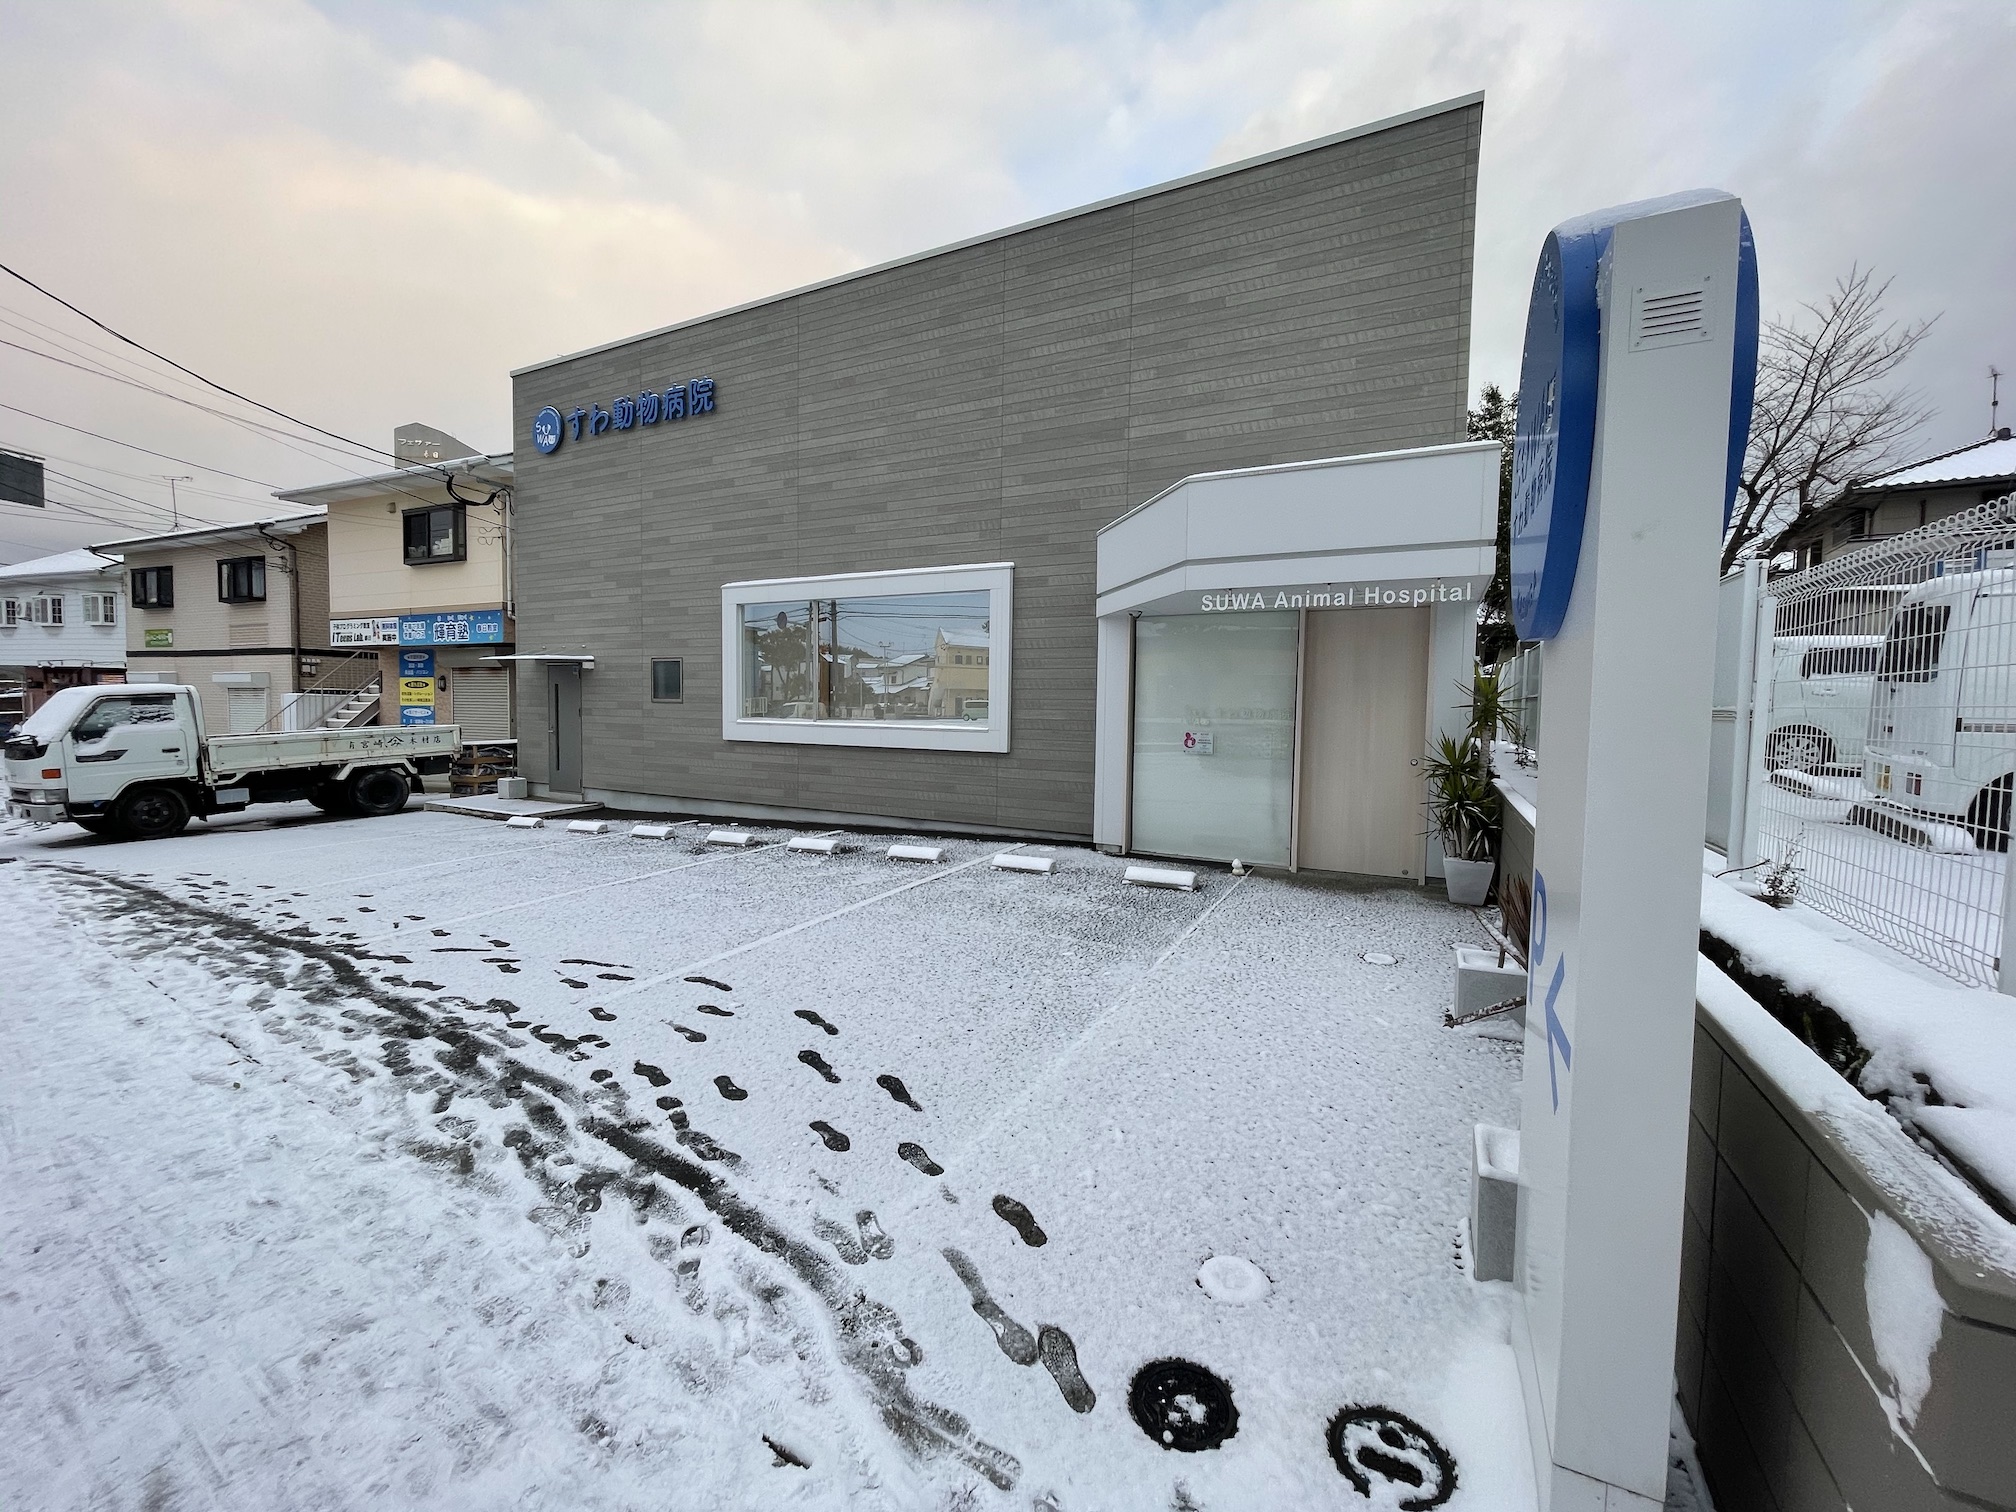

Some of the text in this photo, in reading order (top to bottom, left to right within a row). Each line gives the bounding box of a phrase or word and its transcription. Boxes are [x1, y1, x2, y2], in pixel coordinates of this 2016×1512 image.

[566, 376, 716, 441] すわ動物病院
[1201, 582, 1473, 612] SUWA Animal Hospital
[433, 621, 469, 641] 輝育塾
[1528, 868, 1547, 1006] P
